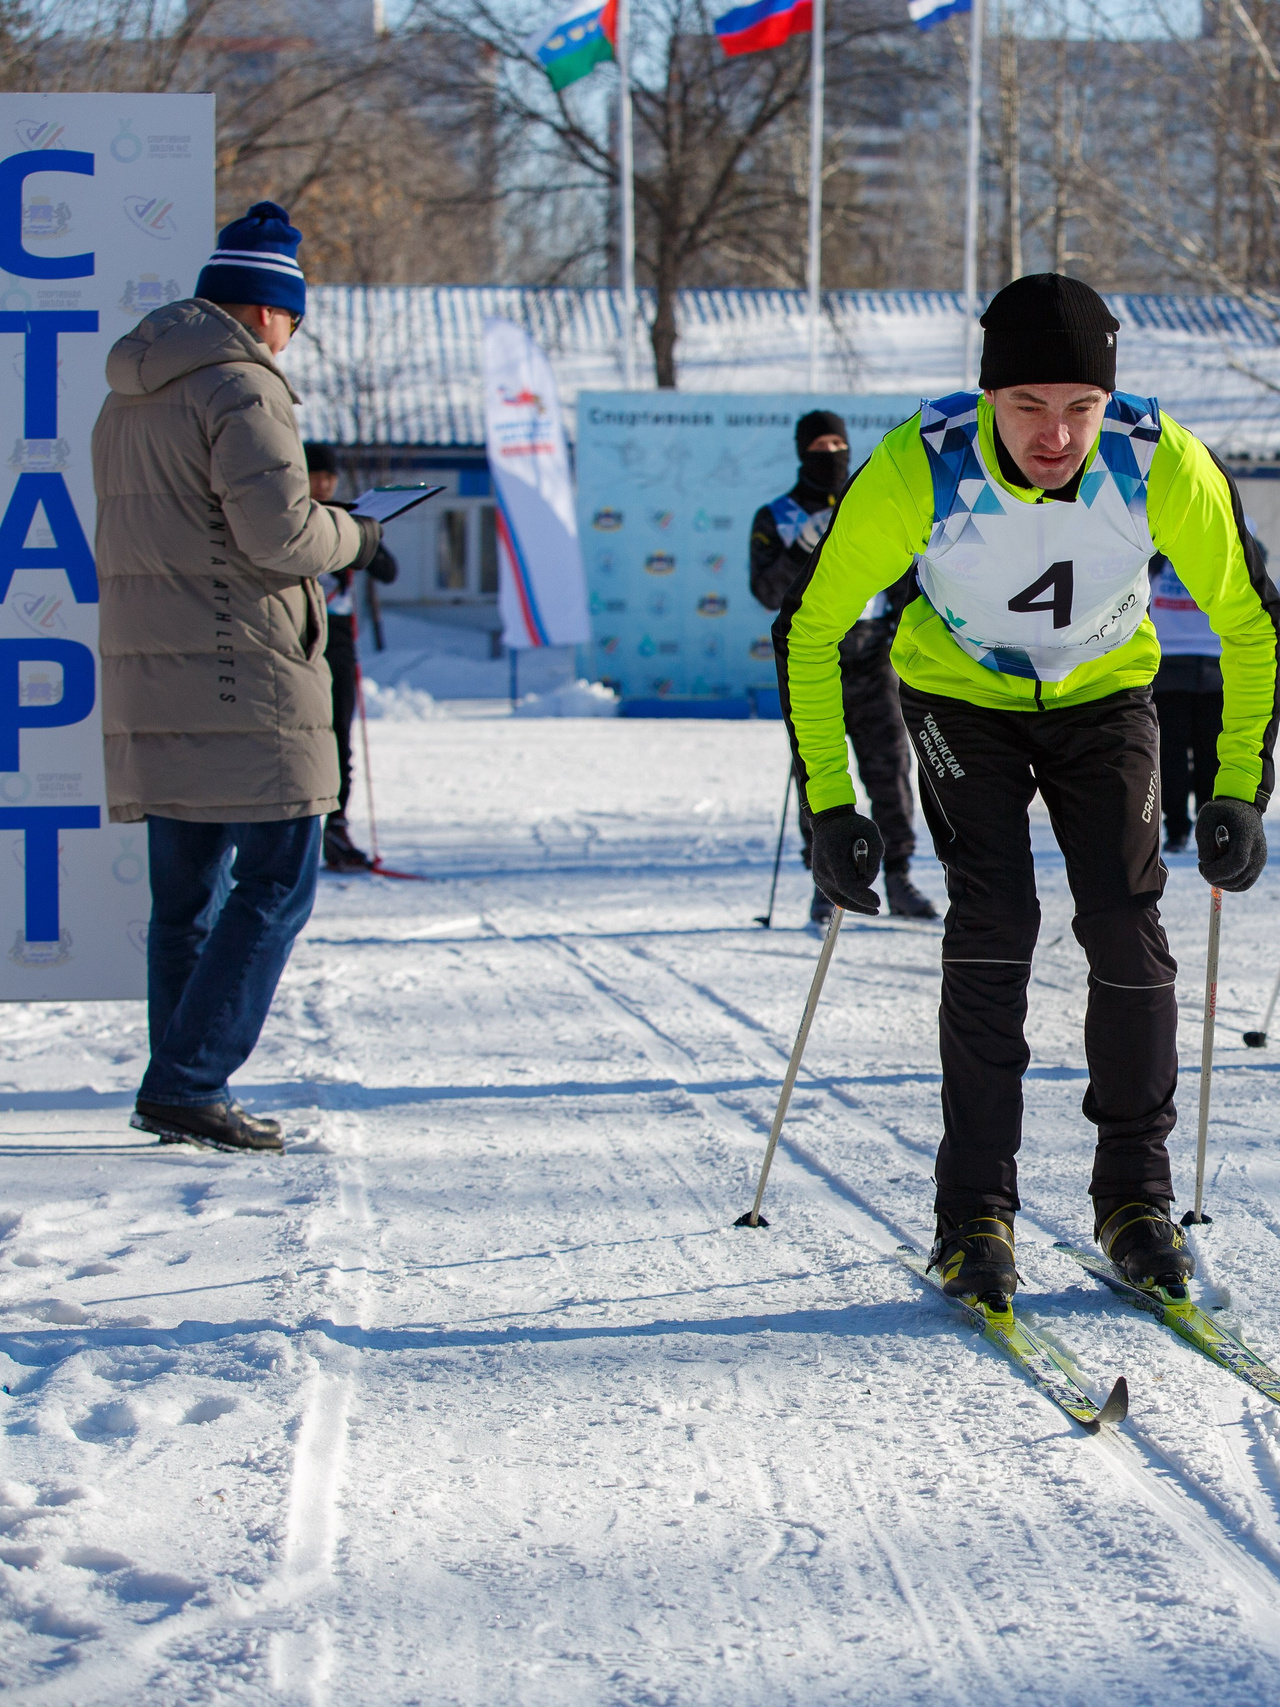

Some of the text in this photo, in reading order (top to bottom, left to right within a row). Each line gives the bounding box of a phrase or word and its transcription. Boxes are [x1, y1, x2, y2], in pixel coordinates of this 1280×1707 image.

[590, 409, 713, 428] Спортивная
[725, 411, 791, 427] школа
[0, 149, 100, 942] СТАРТ
[1008, 560, 1074, 630] 4
[213, 580, 237, 703] ATHLETES
[918, 729, 946, 779] ОБЛАСТЬ
[924, 712, 966, 779] ТЮМЕНСКАЯ
[1141, 777, 1157, 824] CRAFT
